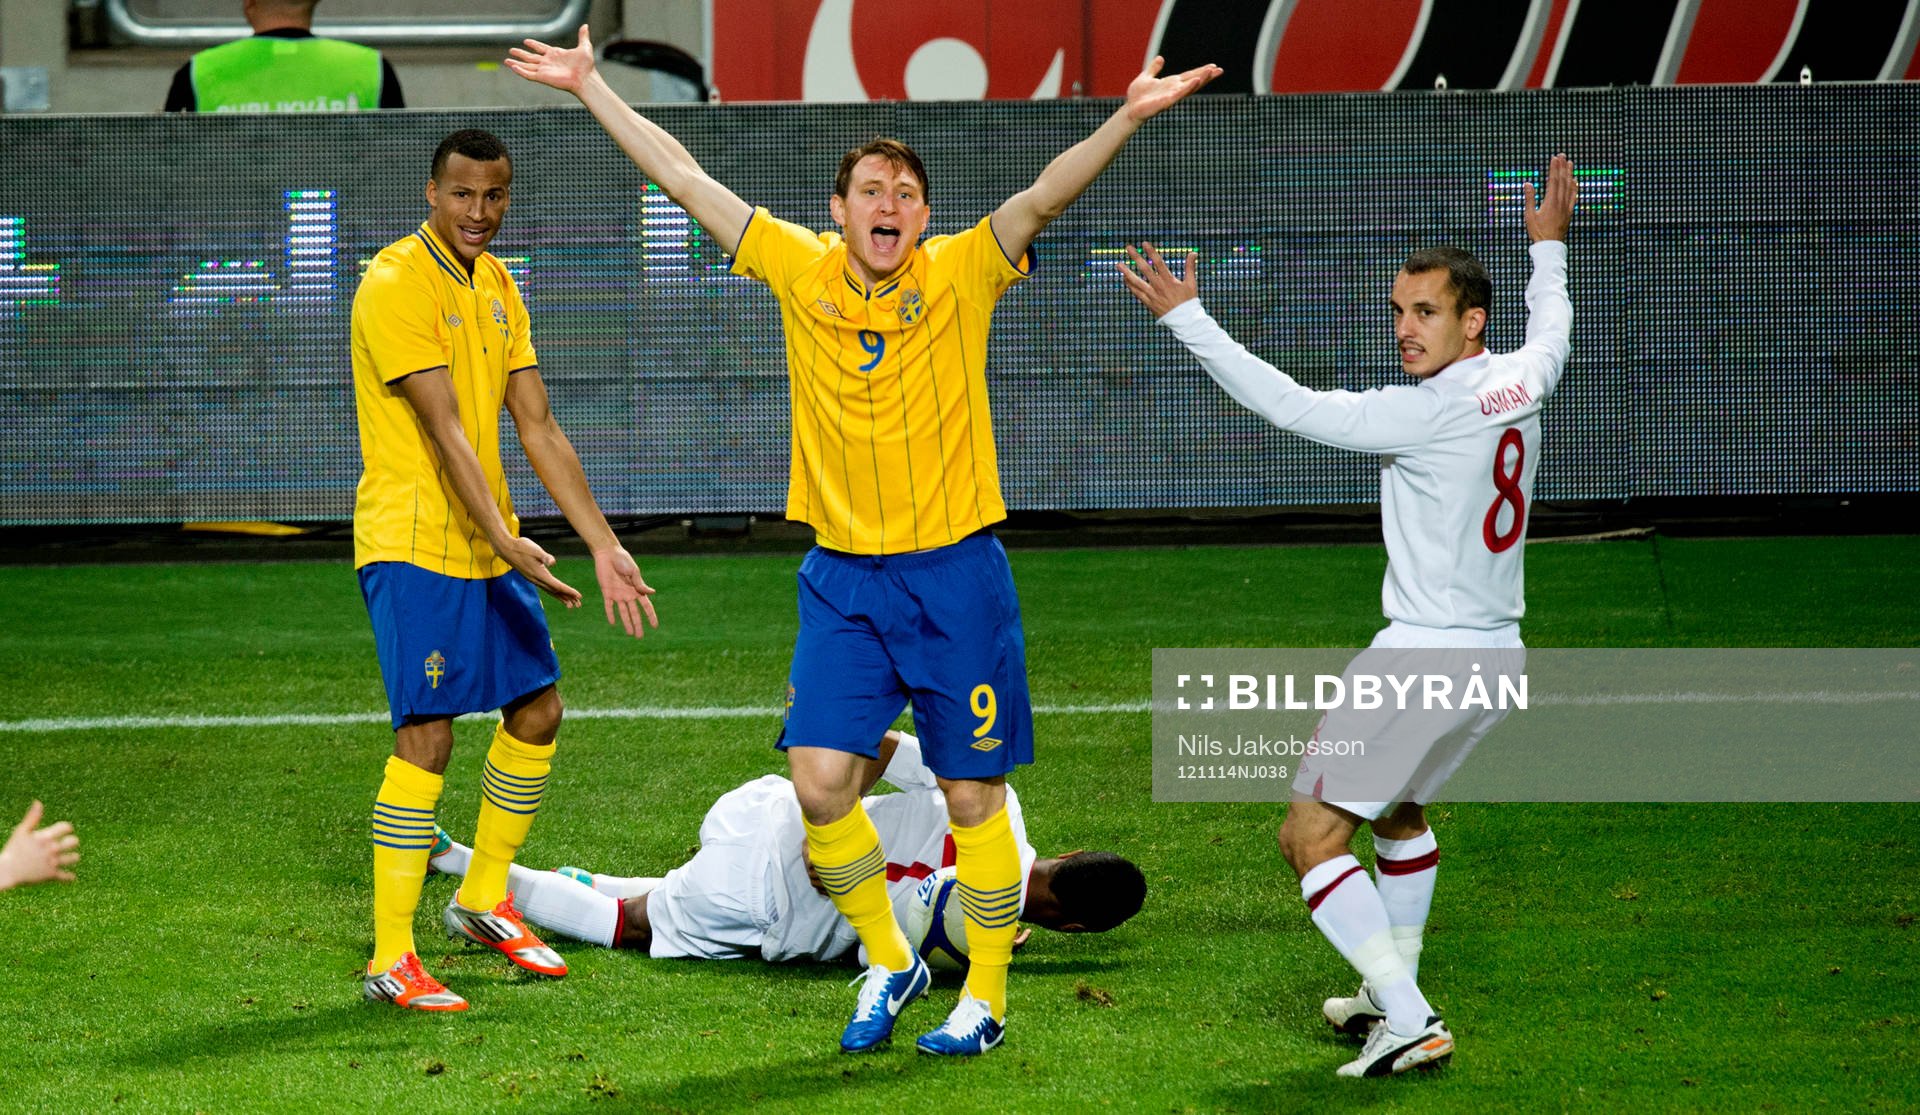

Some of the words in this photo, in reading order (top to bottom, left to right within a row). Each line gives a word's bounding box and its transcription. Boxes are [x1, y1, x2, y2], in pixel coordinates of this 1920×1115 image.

[858, 329, 885, 371] 9
[1483, 427, 1525, 554] 8
[970, 683, 997, 738] 9
